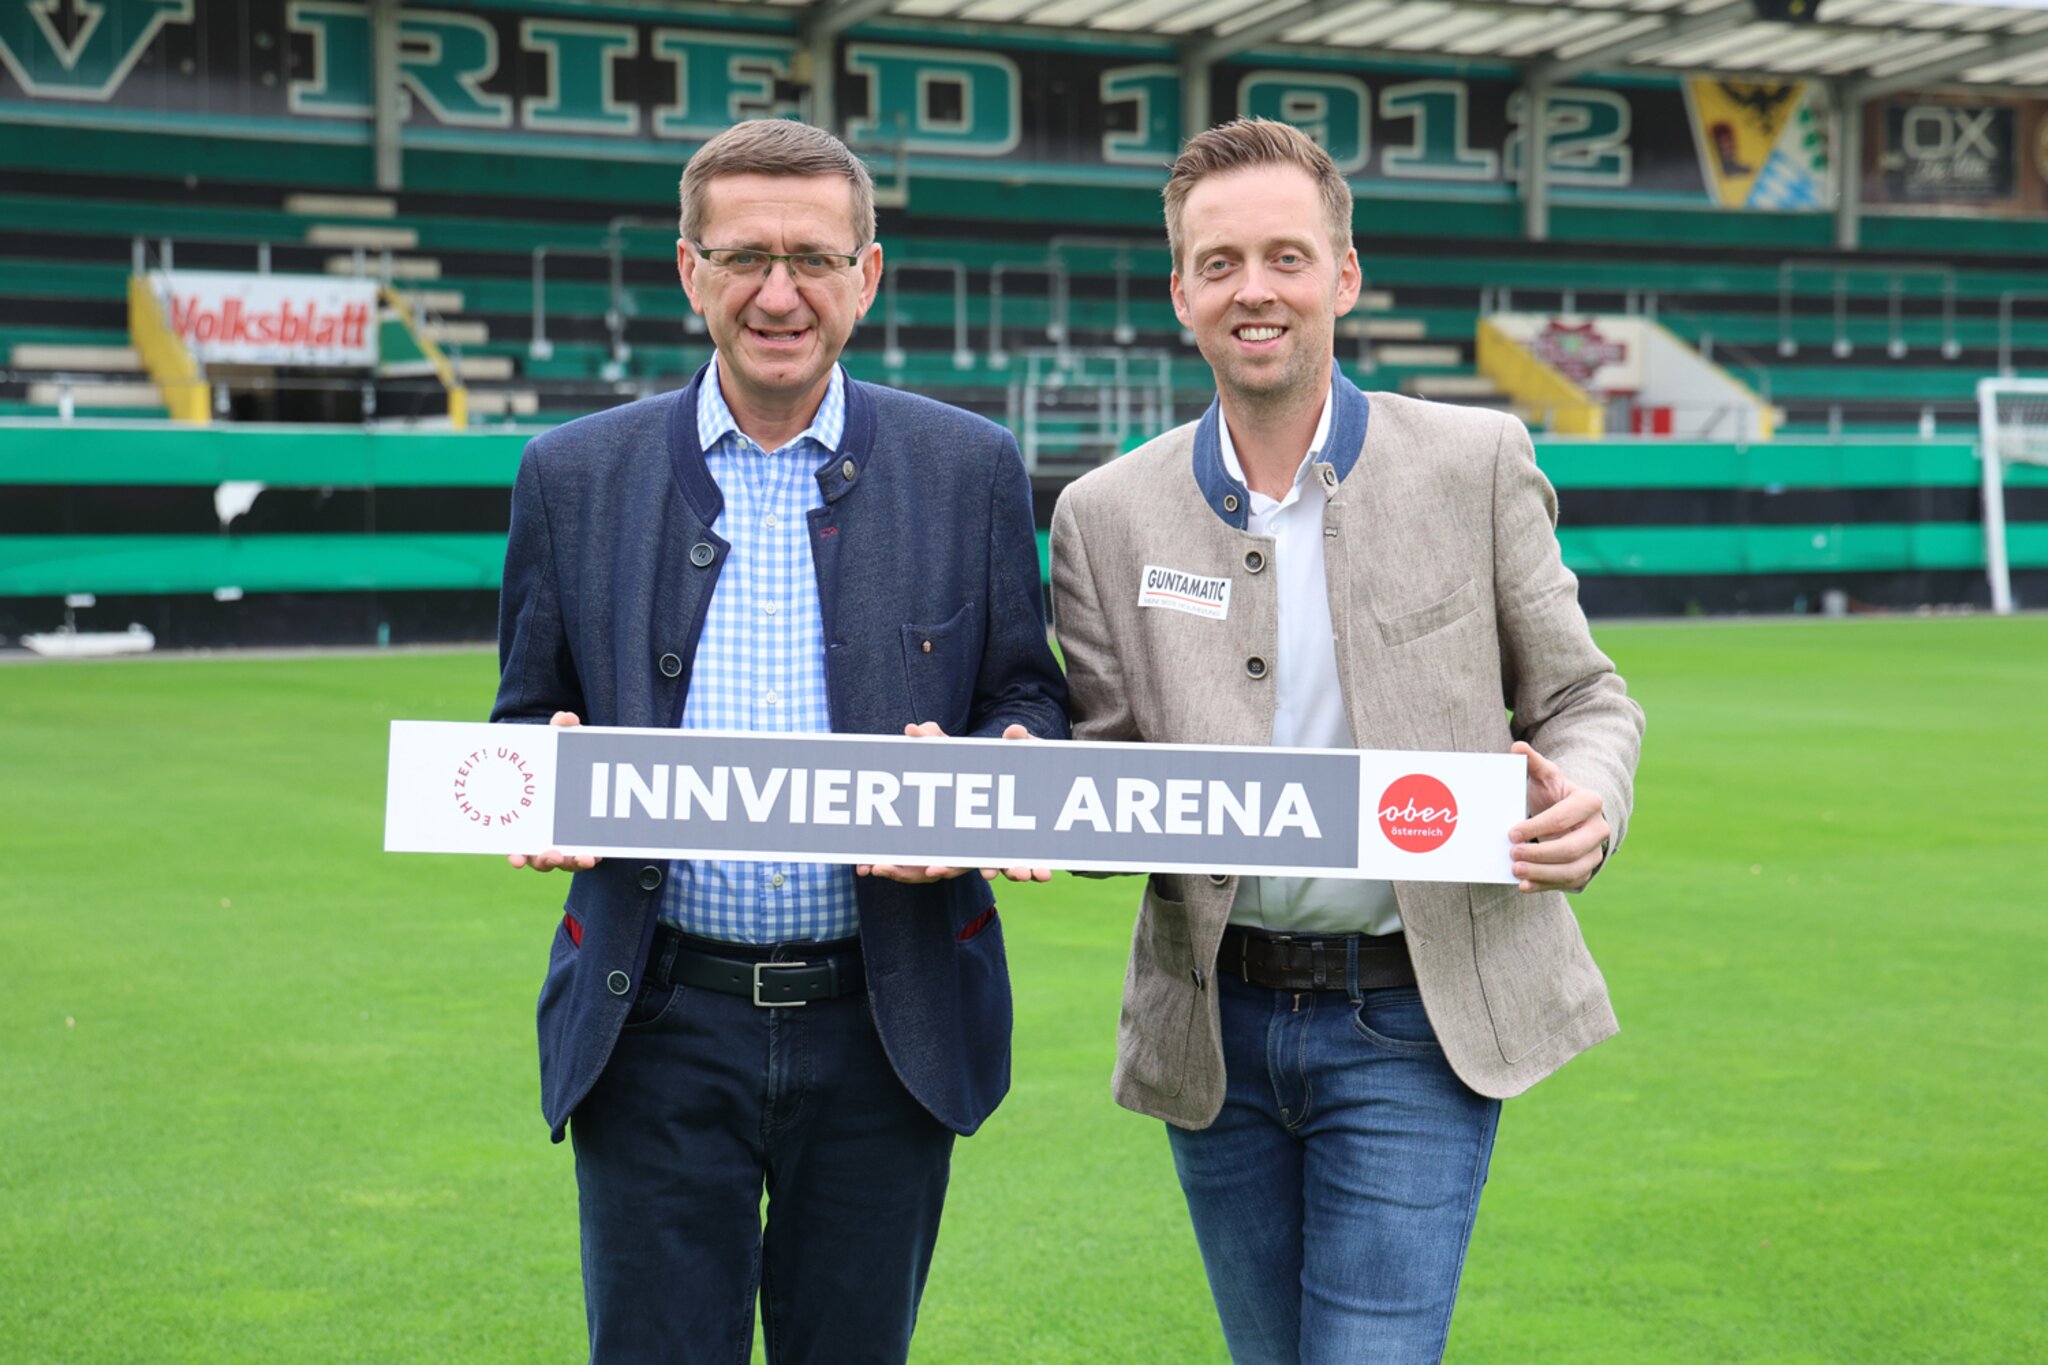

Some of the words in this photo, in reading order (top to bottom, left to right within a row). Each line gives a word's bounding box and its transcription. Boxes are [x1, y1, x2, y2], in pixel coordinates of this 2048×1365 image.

[288, 1, 1021, 156] RIED
[1102, 63, 1633, 188] 1912
[1902, 106, 1998, 160] OX
[171, 292, 369, 348] Volksblatt
[1147, 569, 1226, 602] GUNTAMATIC
[454, 748, 491, 826] ECHTZEIT!
[497, 747, 535, 807] URLAUB
[590, 761, 1037, 832] INNVIERTEL
[1054, 775, 1323, 839] ARENA
[500, 810, 519, 826] IN
[1378, 797, 1459, 823] ober
[1391, 826, 1443, 837] österreich
